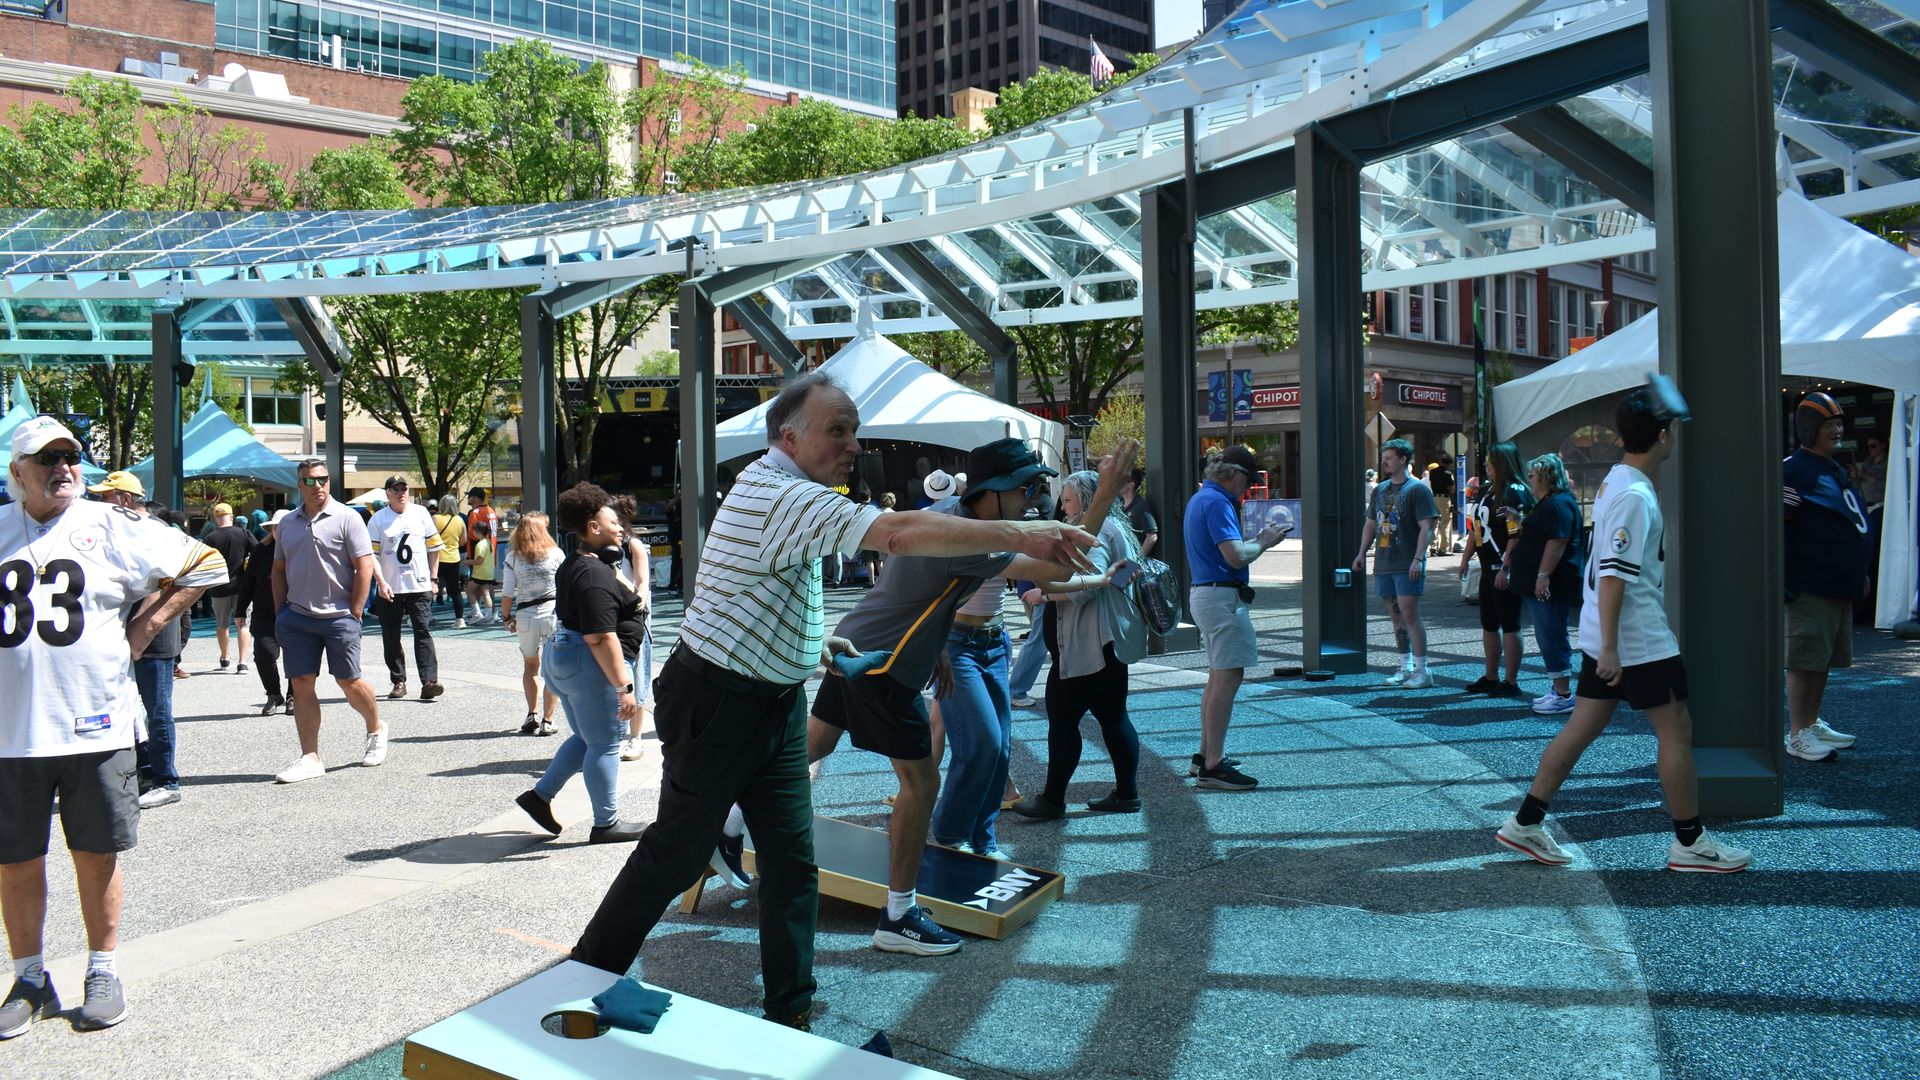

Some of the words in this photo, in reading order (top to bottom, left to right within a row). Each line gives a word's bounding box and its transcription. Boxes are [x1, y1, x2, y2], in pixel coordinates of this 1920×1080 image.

[1254, 391, 1298, 404] CHIPOT
[1412, 389, 1447, 402] CHIPOTLE
[1843, 488, 1868, 534] 9
[396, 533, 412, 564] 6
[639, 535, 669, 544] BURG
[0, 558, 86, 647] 83
[974, 867, 1041, 902] BNY
[901, 927, 921, 941] HOKA
